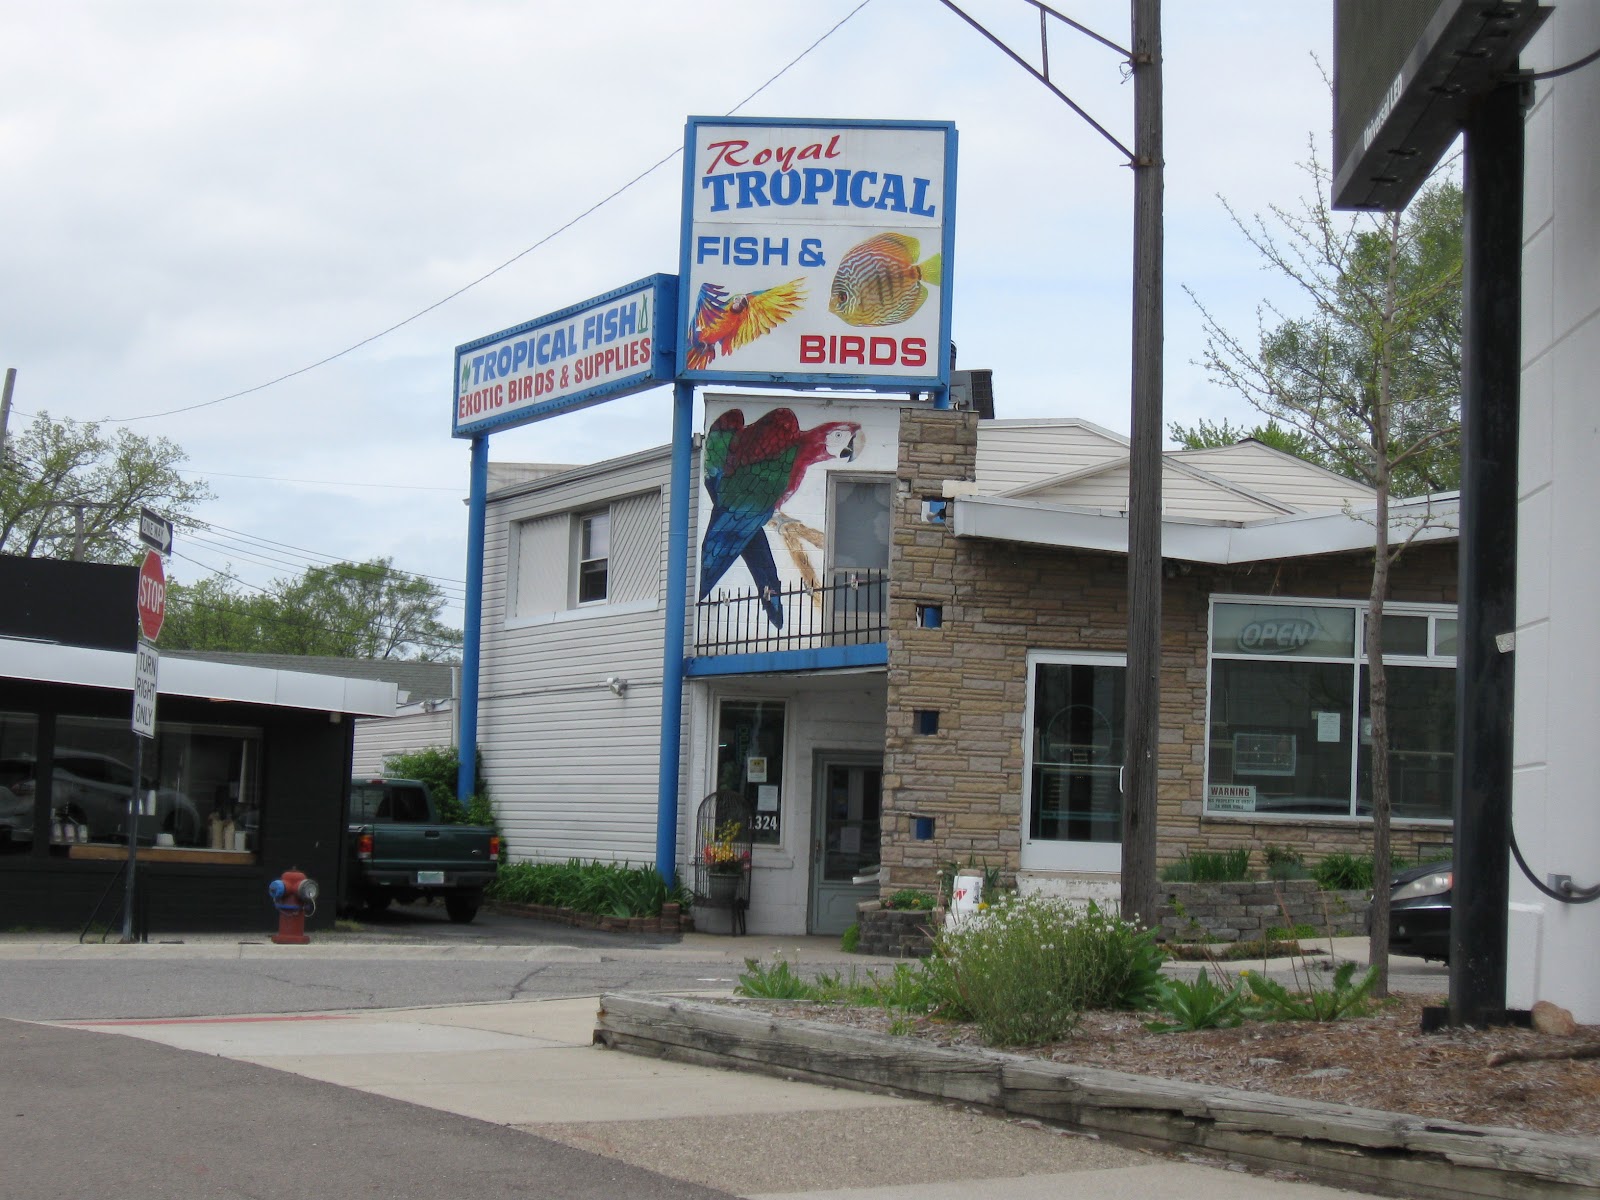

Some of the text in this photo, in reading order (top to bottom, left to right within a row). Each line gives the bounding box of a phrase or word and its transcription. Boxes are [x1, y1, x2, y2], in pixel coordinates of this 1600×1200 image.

[1363, 73, 1403, 152] Universal LED
[707, 135, 840, 175] Royal
[702, 167, 936, 217] TROPICAL
[697, 236, 826, 267] FISH &
[472, 301, 637, 385] TROPICAL FISH
[800, 335, 927, 367] BIRDS
[458, 337, 651, 419] EXOTIC BIRDS & SUPPLIES
[142, 517, 164, 542] ONE WAY
[140, 574, 164, 615] STOP
[1242, 622, 1311, 646] OPEN
[139, 651, 156, 677] TURN
[136, 677, 156, 702] RIGHT
[135, 704, 153, 727] ONLY
[1210, 786, 1250, 797] WARNING
